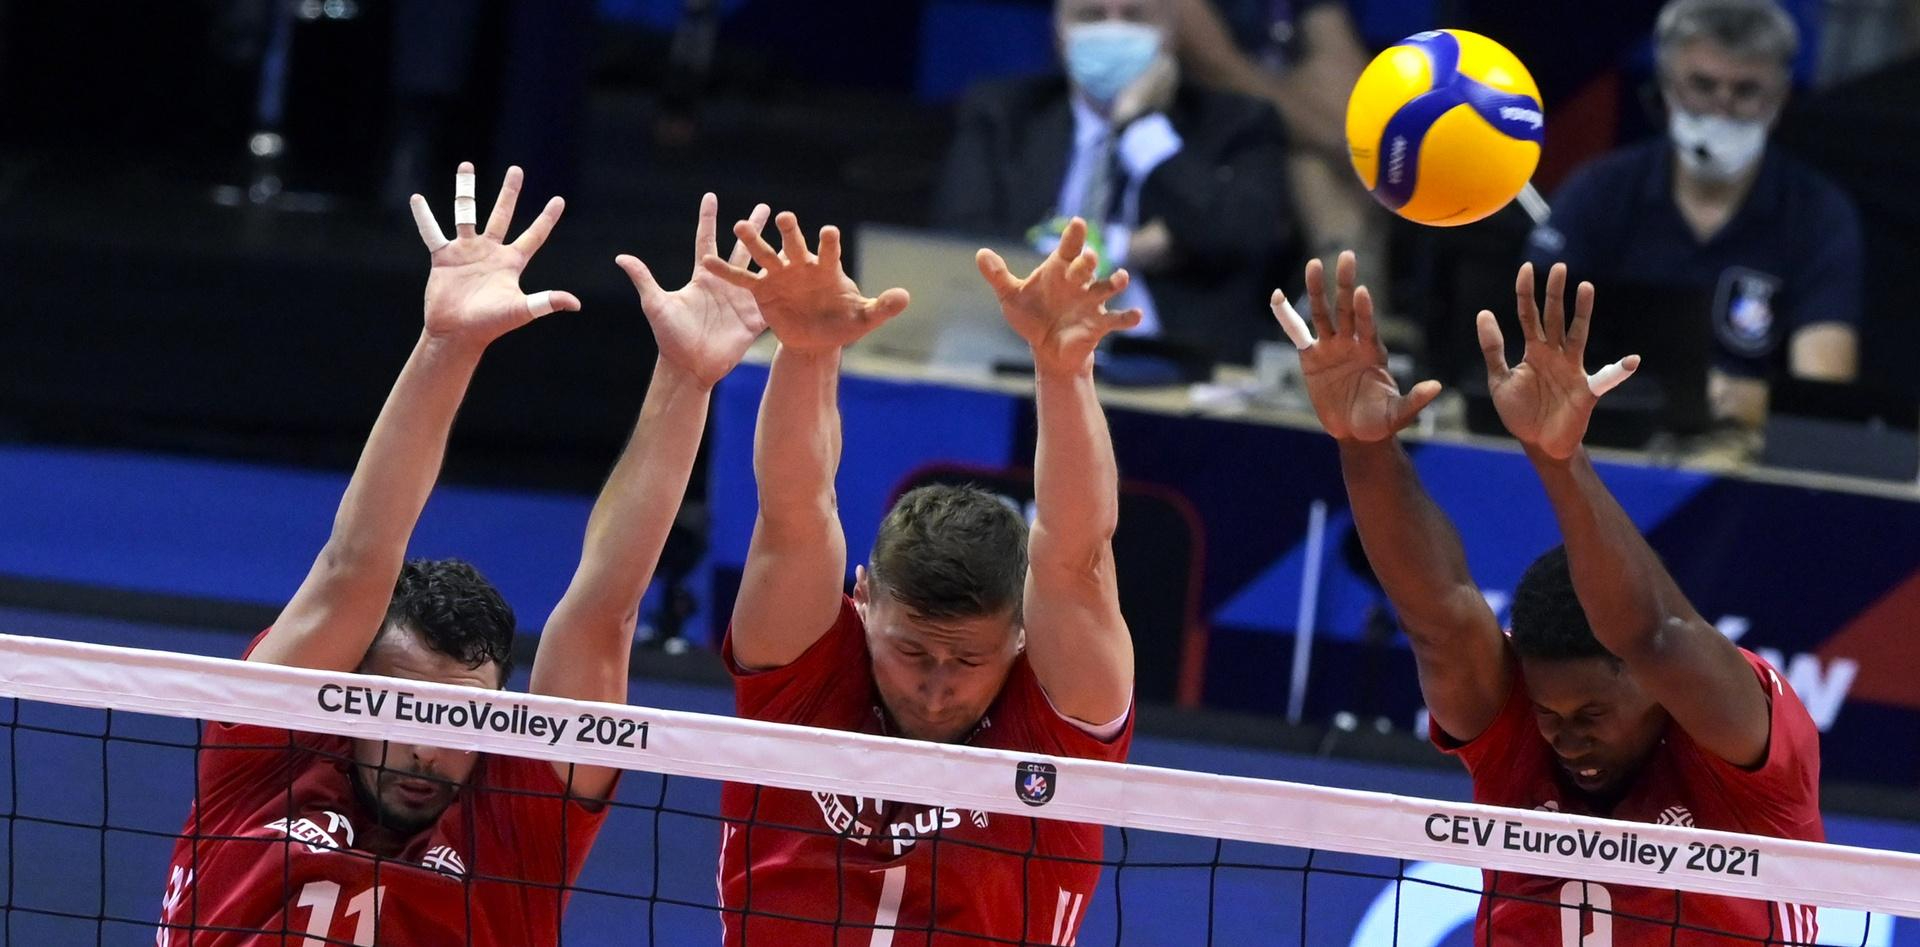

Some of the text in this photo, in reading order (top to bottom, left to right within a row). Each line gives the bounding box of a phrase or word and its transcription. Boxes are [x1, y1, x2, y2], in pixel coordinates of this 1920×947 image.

[318, 684, 649, 749] CEV EuroVolley 2021
[1425, 813, 1759, 877] CEV EuroVolley 2021
[297, 880, 386, 947] 11
